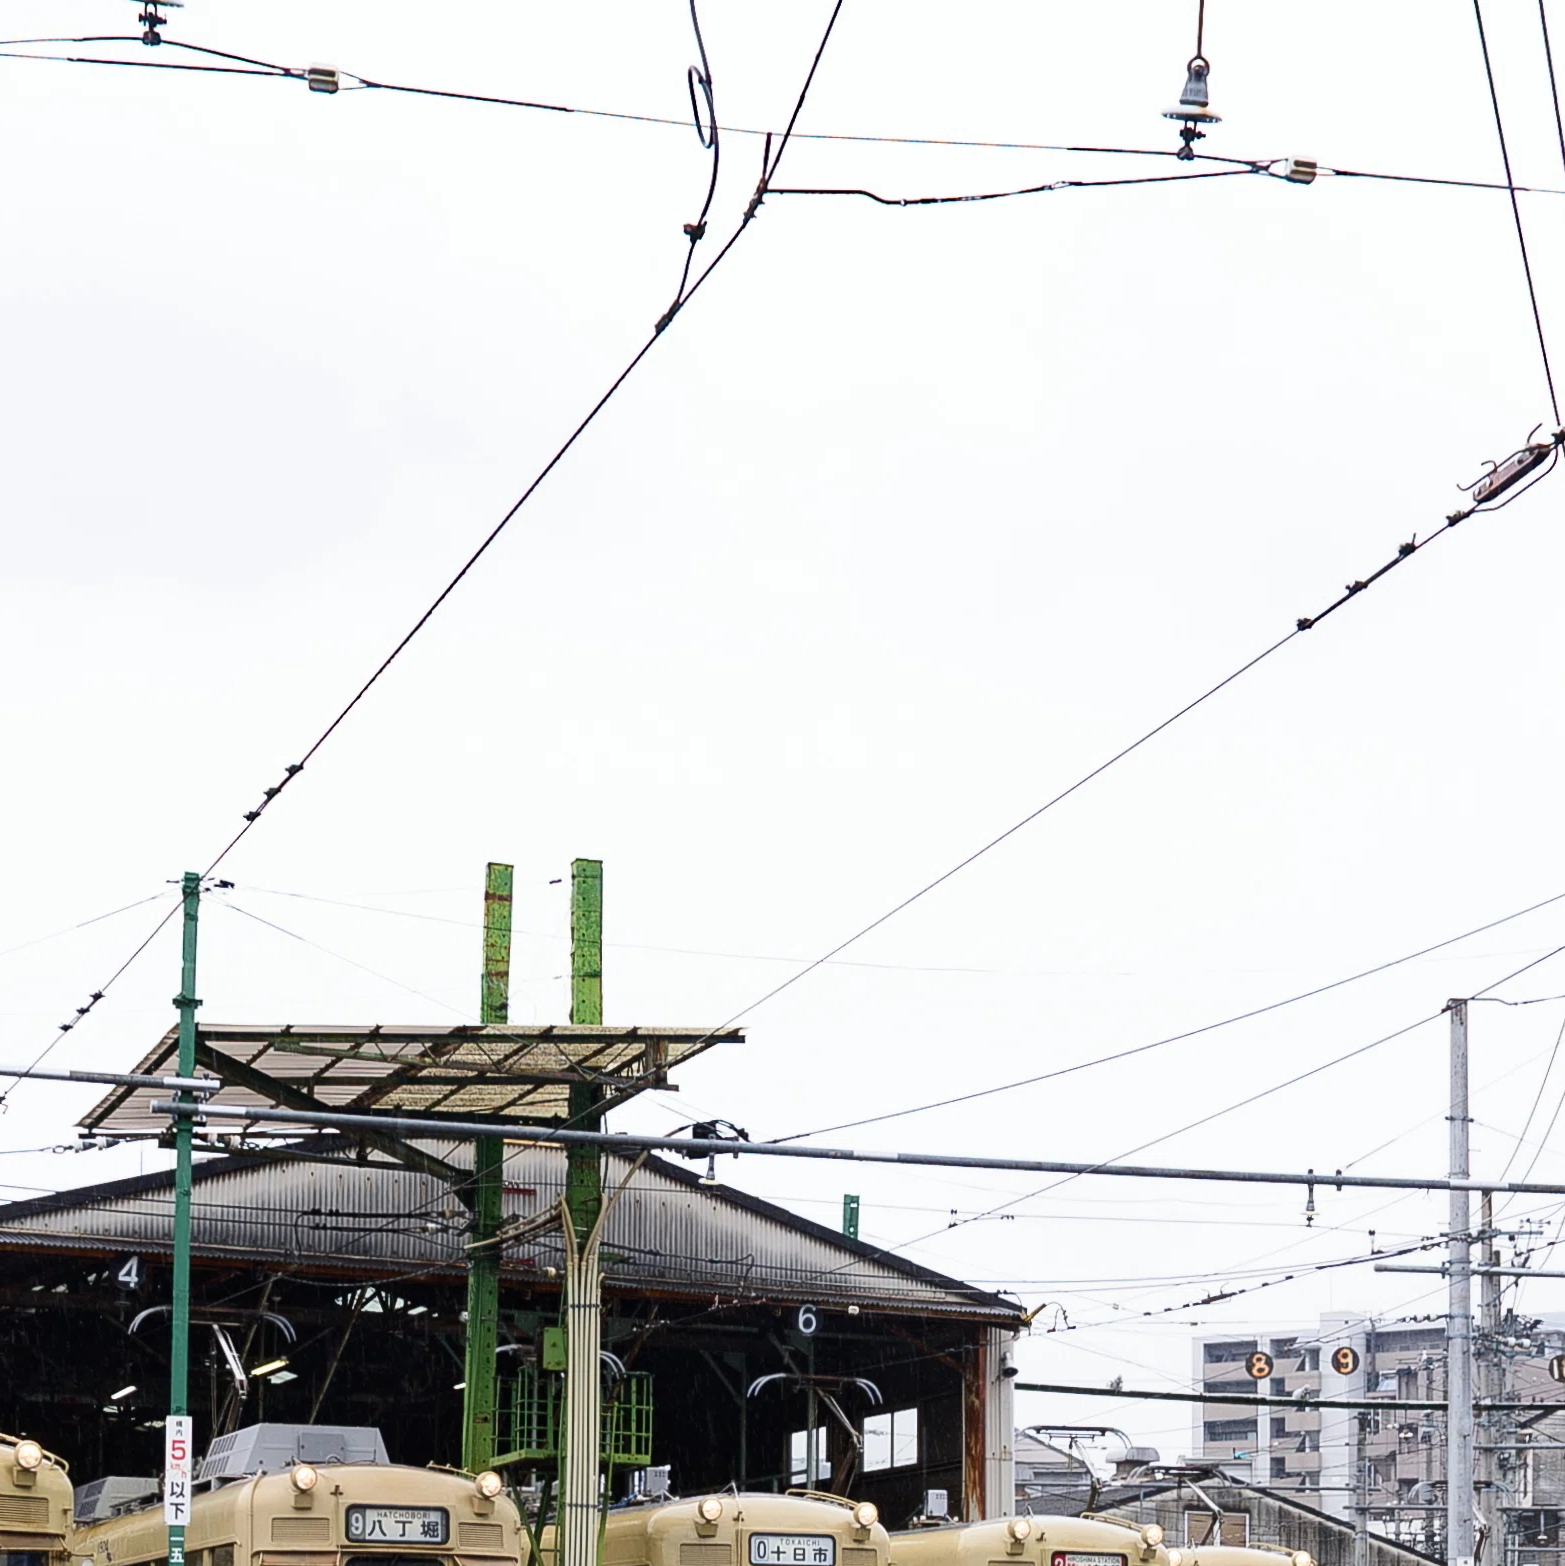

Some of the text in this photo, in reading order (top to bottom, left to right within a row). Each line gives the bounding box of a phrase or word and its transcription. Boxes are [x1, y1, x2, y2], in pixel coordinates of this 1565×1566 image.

[118, 1256, 138, 1287] 4
[798, 1304, 816, 1333] 6
[1252, 1353, 1269, 1377] 8
[1337, 1349, 1353, 1373] 9
[171, 1440, 186, 1460] 5
[170, 1481, 185, 1520] 以下
[351, 1513, 363, 1535] 9
[377, 1511, 431, 1520] HATCHOBORI
[368, 1520, 439, 1539] 八丁堀
[757, 1540, 767, 1559] 0
[780, 1538, 820, 1547] TOKAICHI
[770, 1545, 829, 1563] 十日市
